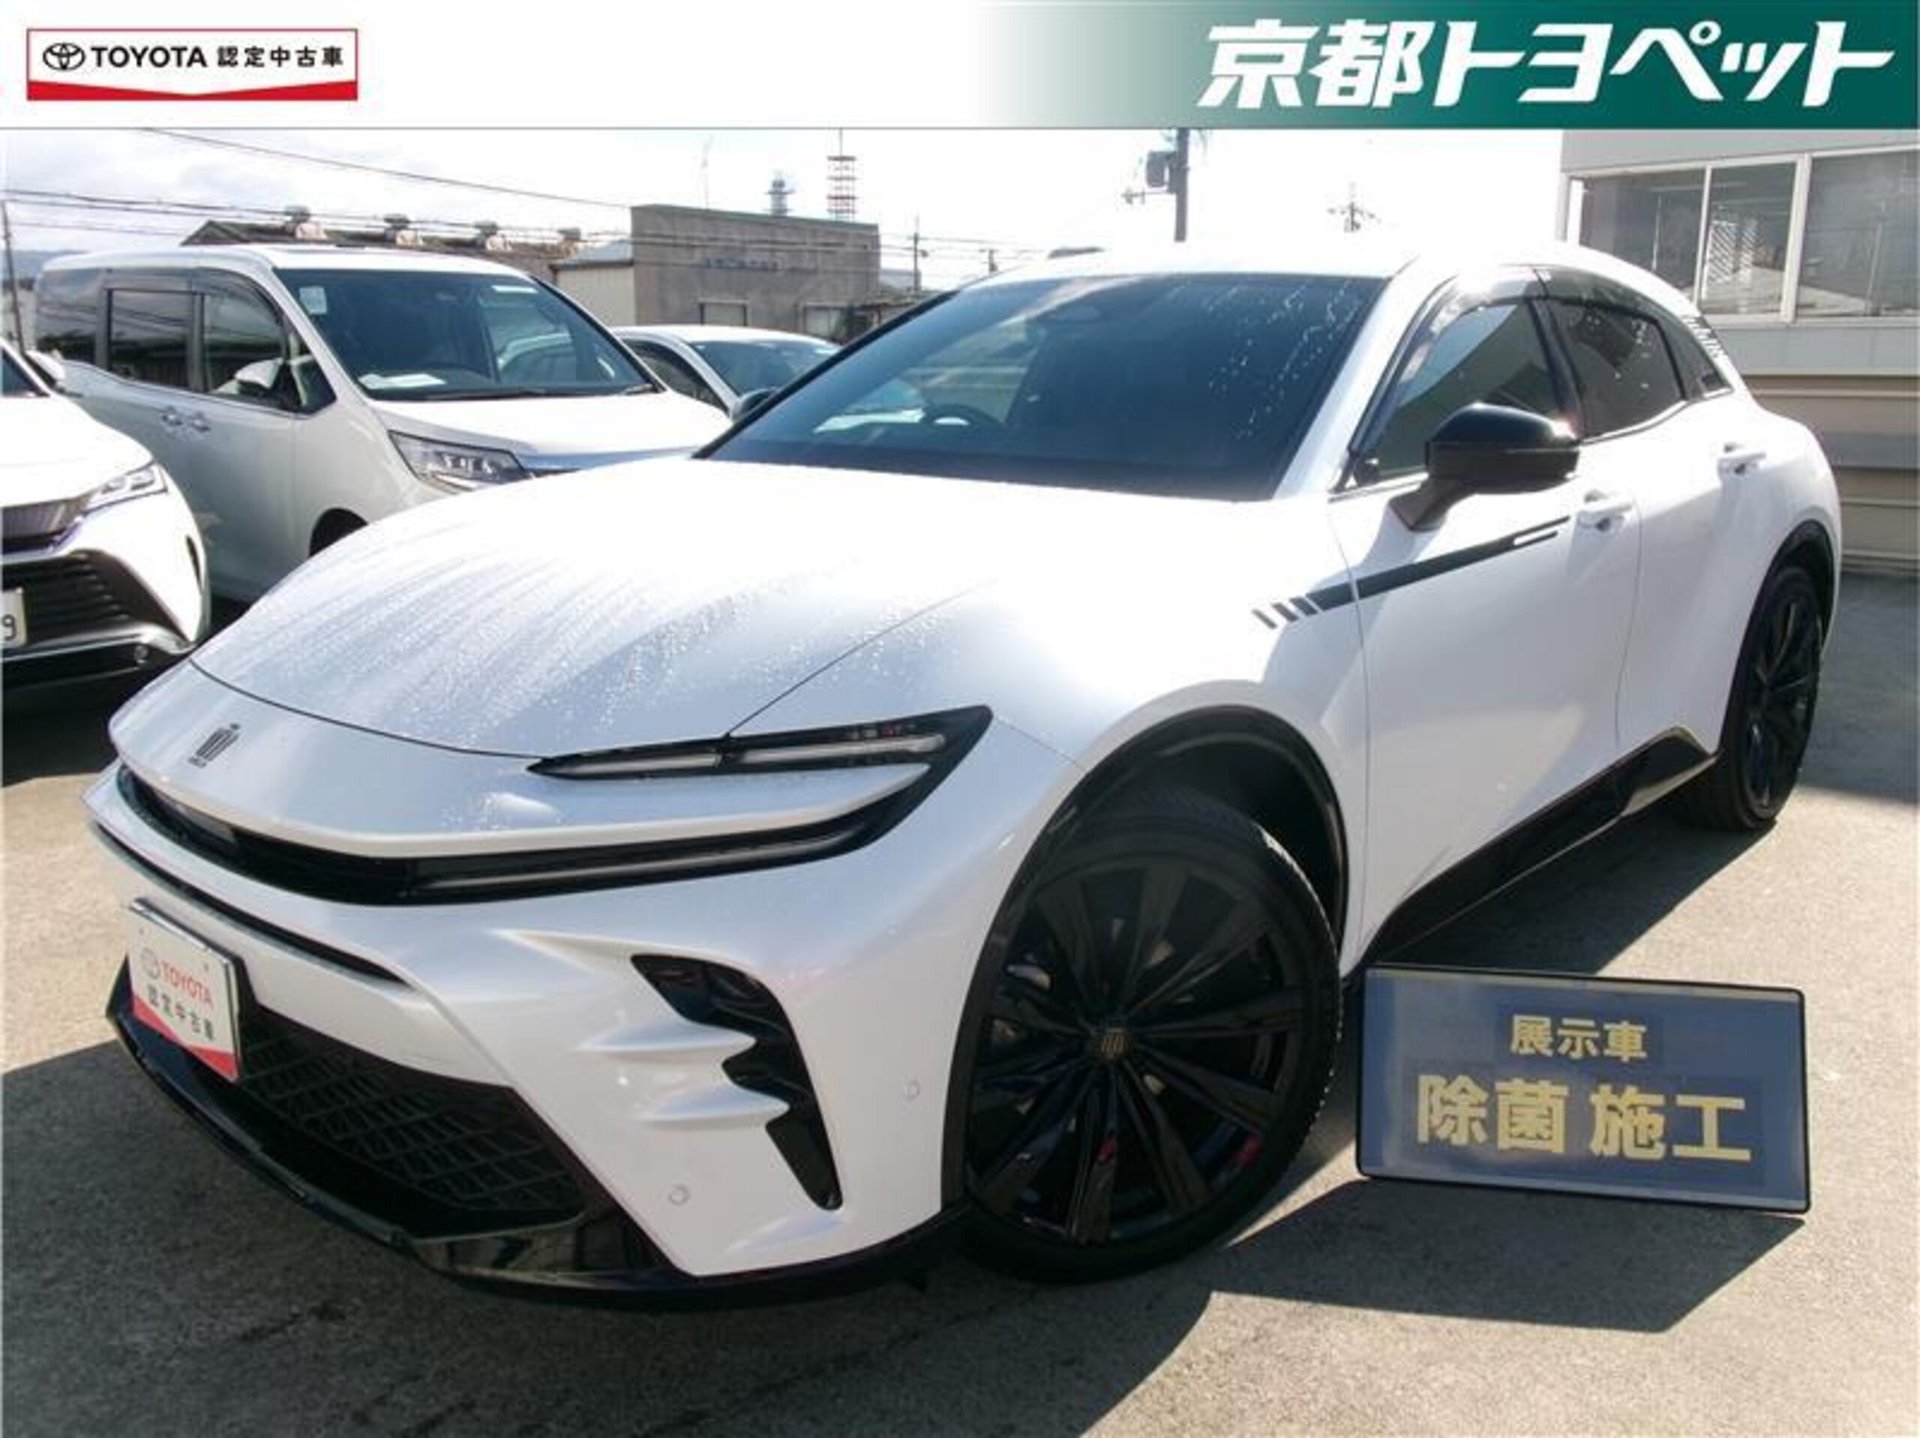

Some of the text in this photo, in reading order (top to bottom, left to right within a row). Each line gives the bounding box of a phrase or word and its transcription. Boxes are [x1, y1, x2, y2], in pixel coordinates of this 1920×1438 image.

[159, 961, 214, 1011] TOYOTA
[1510, 1013, 1648, 1062] 展示車
[1417, 1074, 1751, 1161] 除菌 施工
